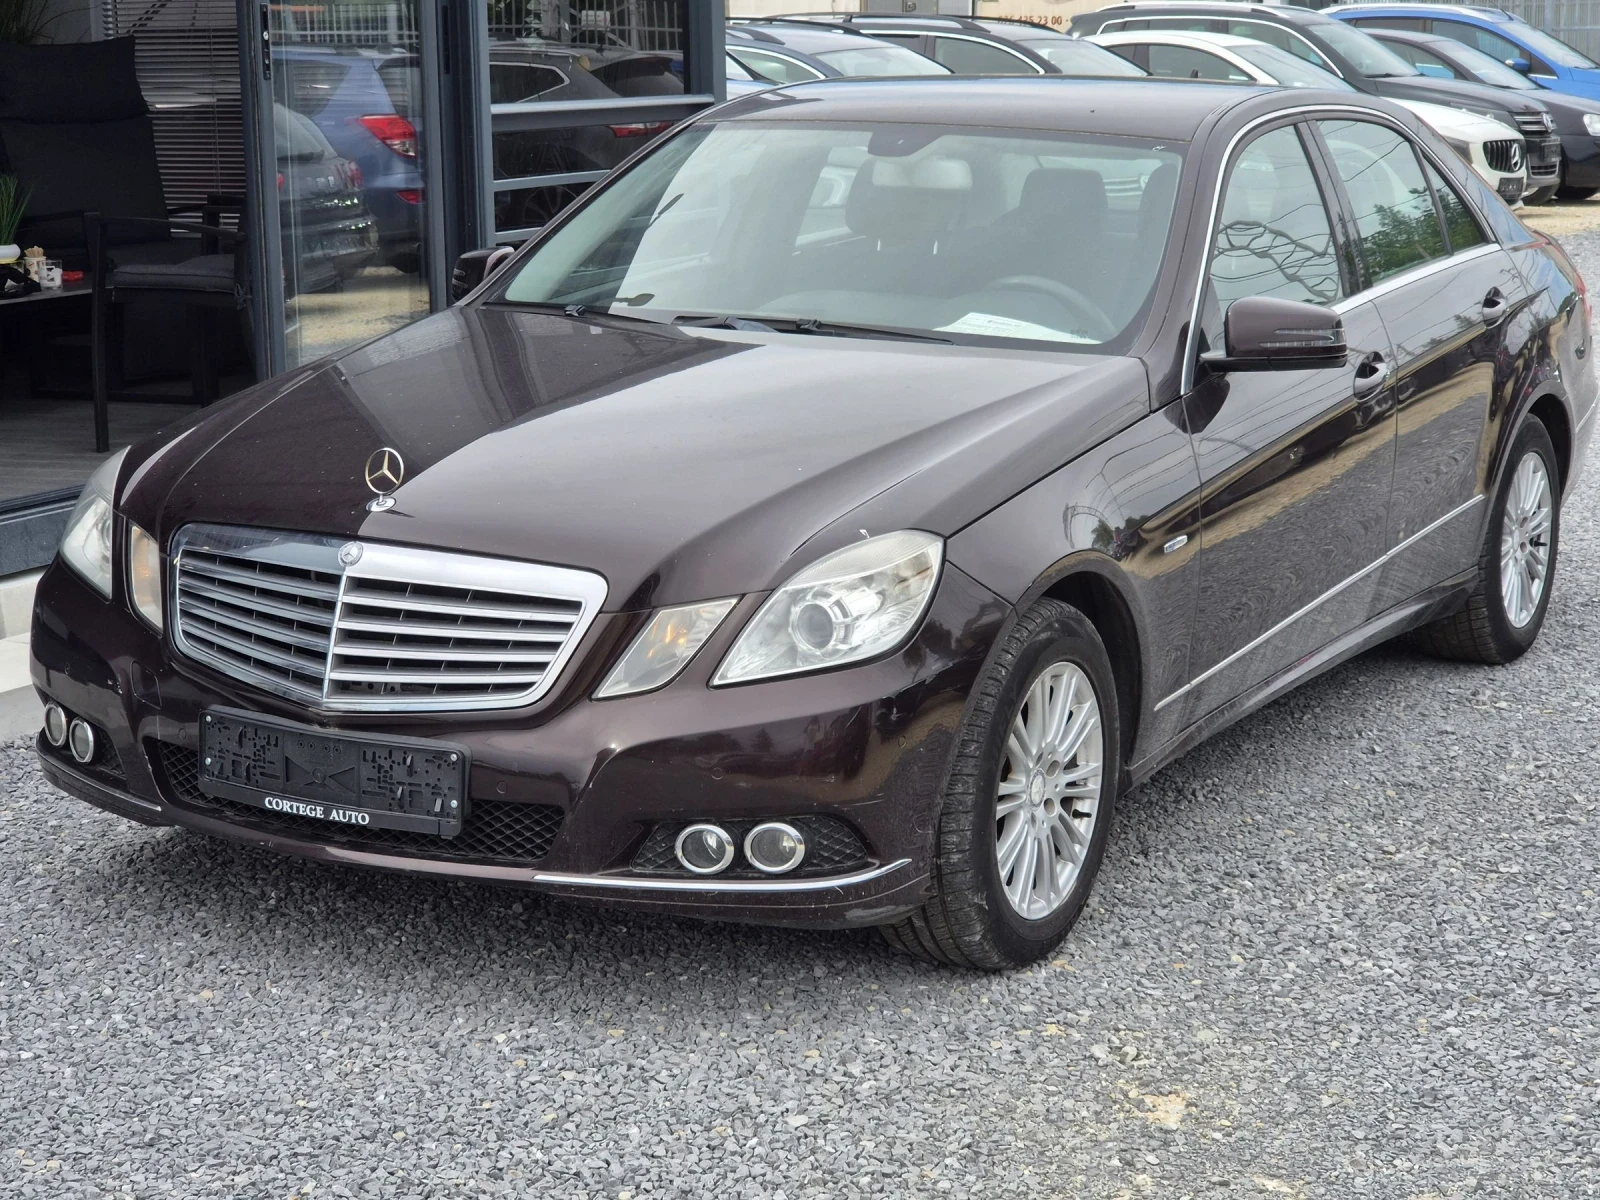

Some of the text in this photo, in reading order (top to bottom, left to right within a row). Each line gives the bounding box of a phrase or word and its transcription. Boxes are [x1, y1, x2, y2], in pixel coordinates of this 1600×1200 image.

[1037, 15, 1048, 25] 23
[1051, 15, 1062, 25] 00
[264, 797, 370, 825] CORTEGE AUTO
